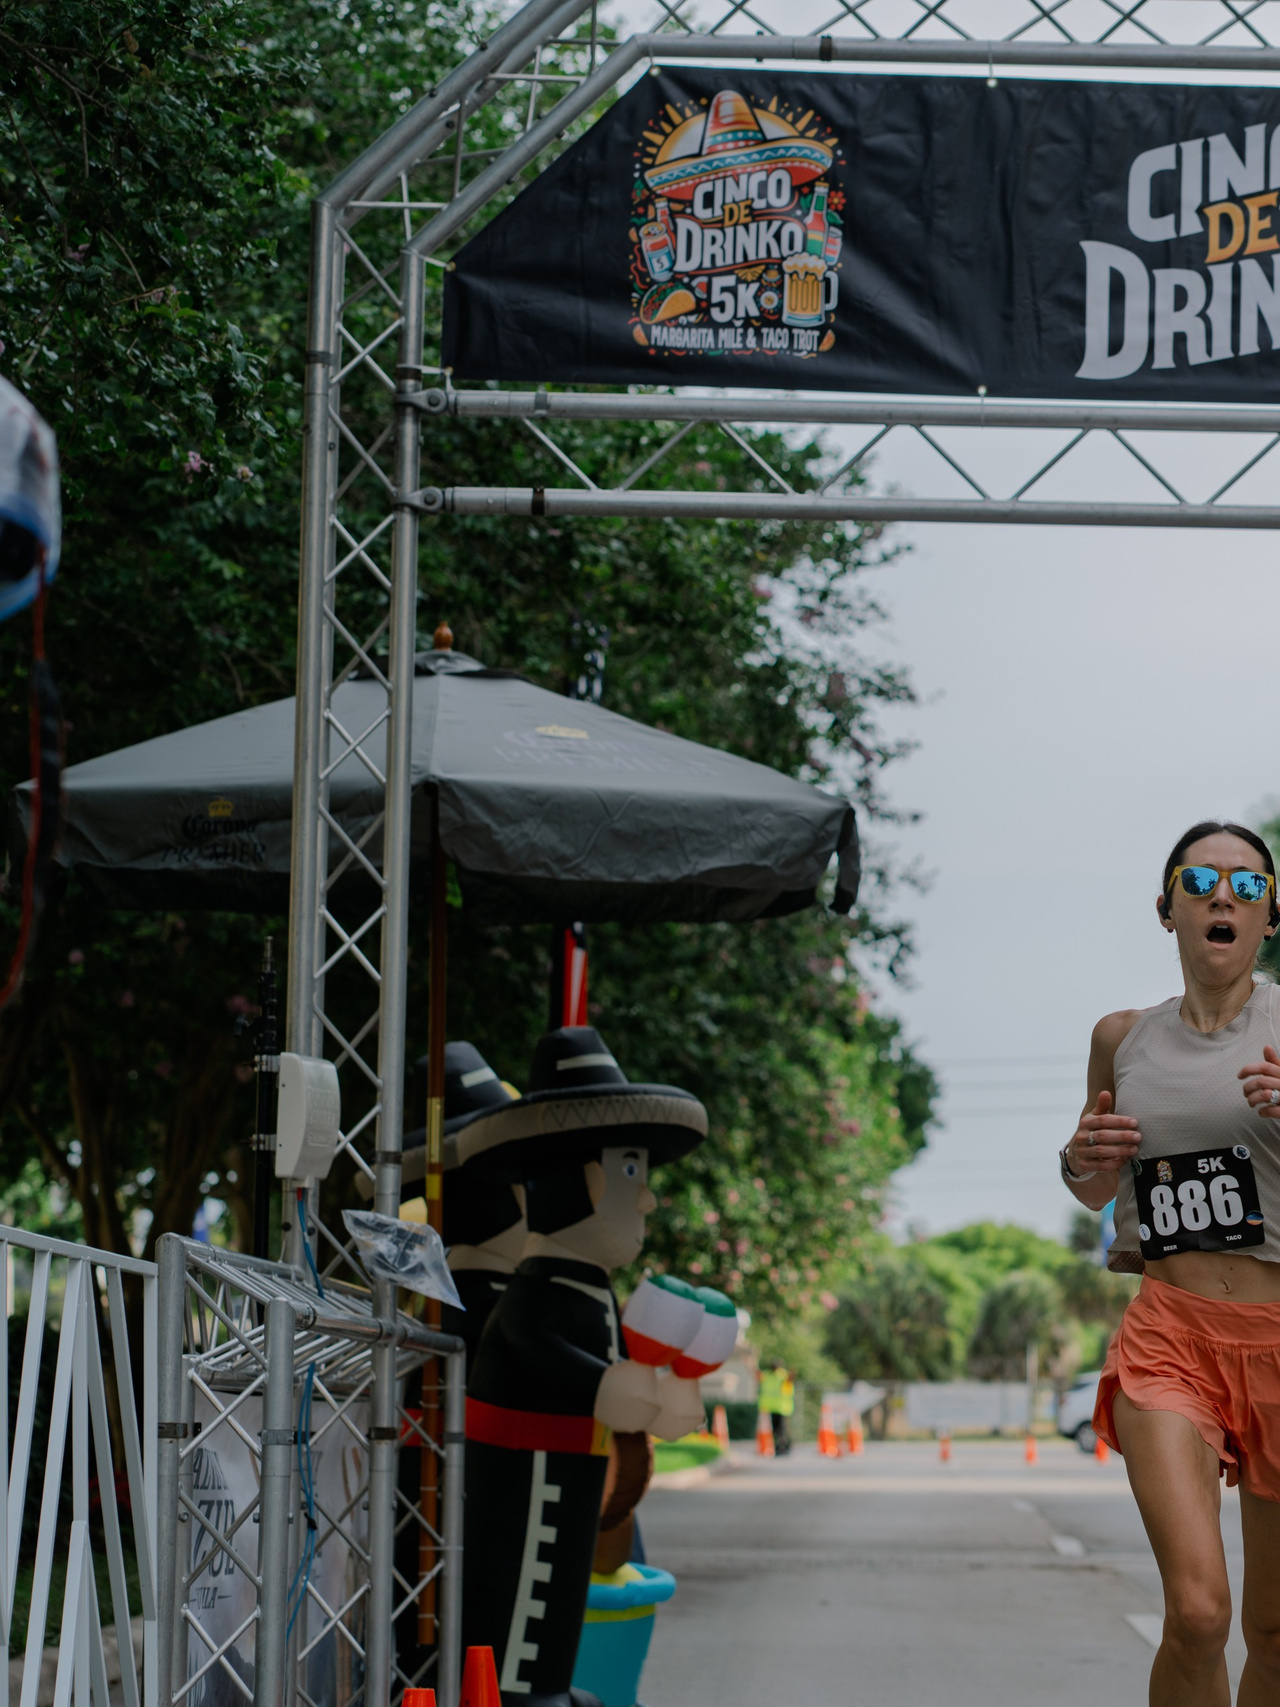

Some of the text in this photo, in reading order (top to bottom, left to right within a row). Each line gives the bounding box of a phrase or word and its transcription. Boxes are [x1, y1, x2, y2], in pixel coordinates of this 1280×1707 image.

[693, 168, 792, 219] CINCO
[723, 200, 753, 227] DE
[673, 217, 804, 272] DRINKO
[1203, 191, 1280, 264] DE
[710, 275, 760, 323] 5K
[651, 324, 820, 351] MARGARITA MILE & TACO TROT
[1197, 1156, 1226, 1174] 5K
[1150, 1175, 1244, 1236] 886
[1163, 1244, 1178, 1252] BEER
